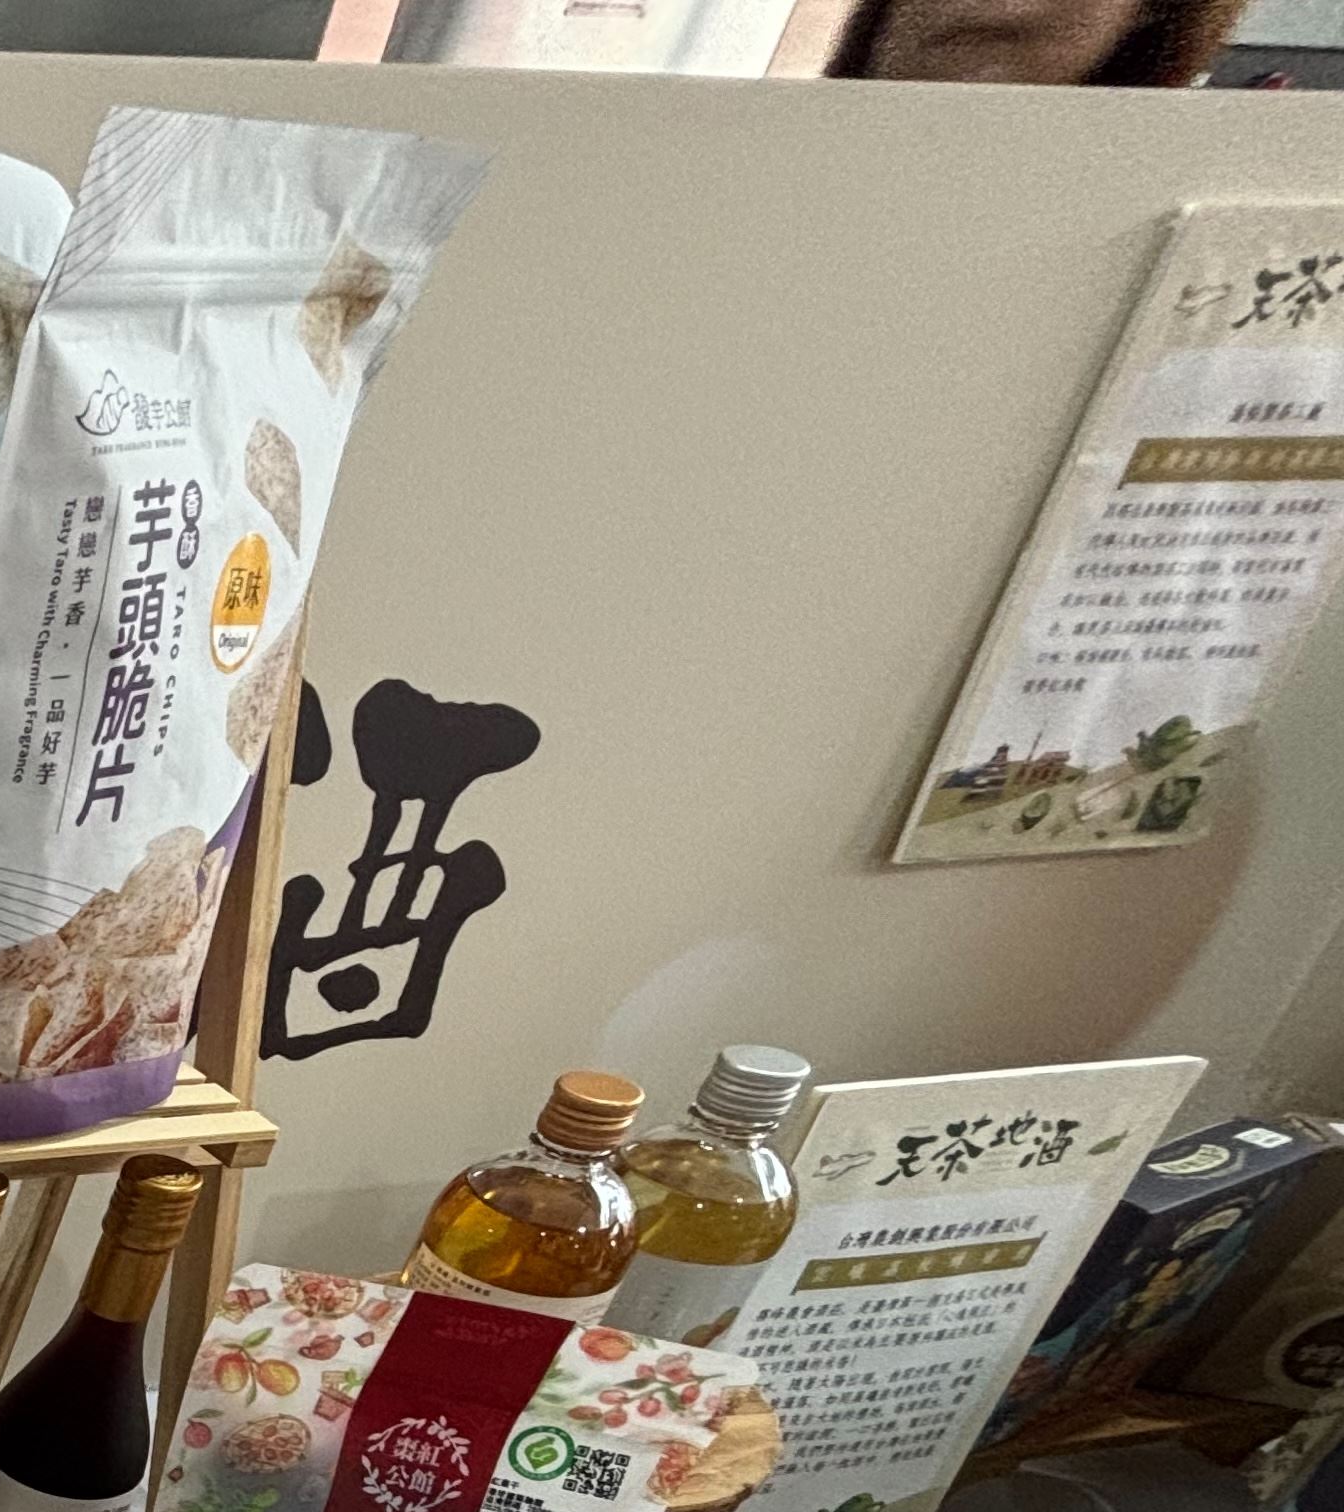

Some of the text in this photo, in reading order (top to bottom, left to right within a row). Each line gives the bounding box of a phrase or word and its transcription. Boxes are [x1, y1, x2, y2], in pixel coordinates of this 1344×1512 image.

[223, 568, 262, 611] 原味
[12, 499, 78, 785] Tasty Taro with Charming Fragrance
[76, 477, 176, 828] 芋頭脆片
[153, 585, 187, 758] TARO CHIPS
[218, 632, 249, 653] Original
[875, 1109, 1082, 1187] 天茶地酒
[386, 1465, 436, 1495] 公館
